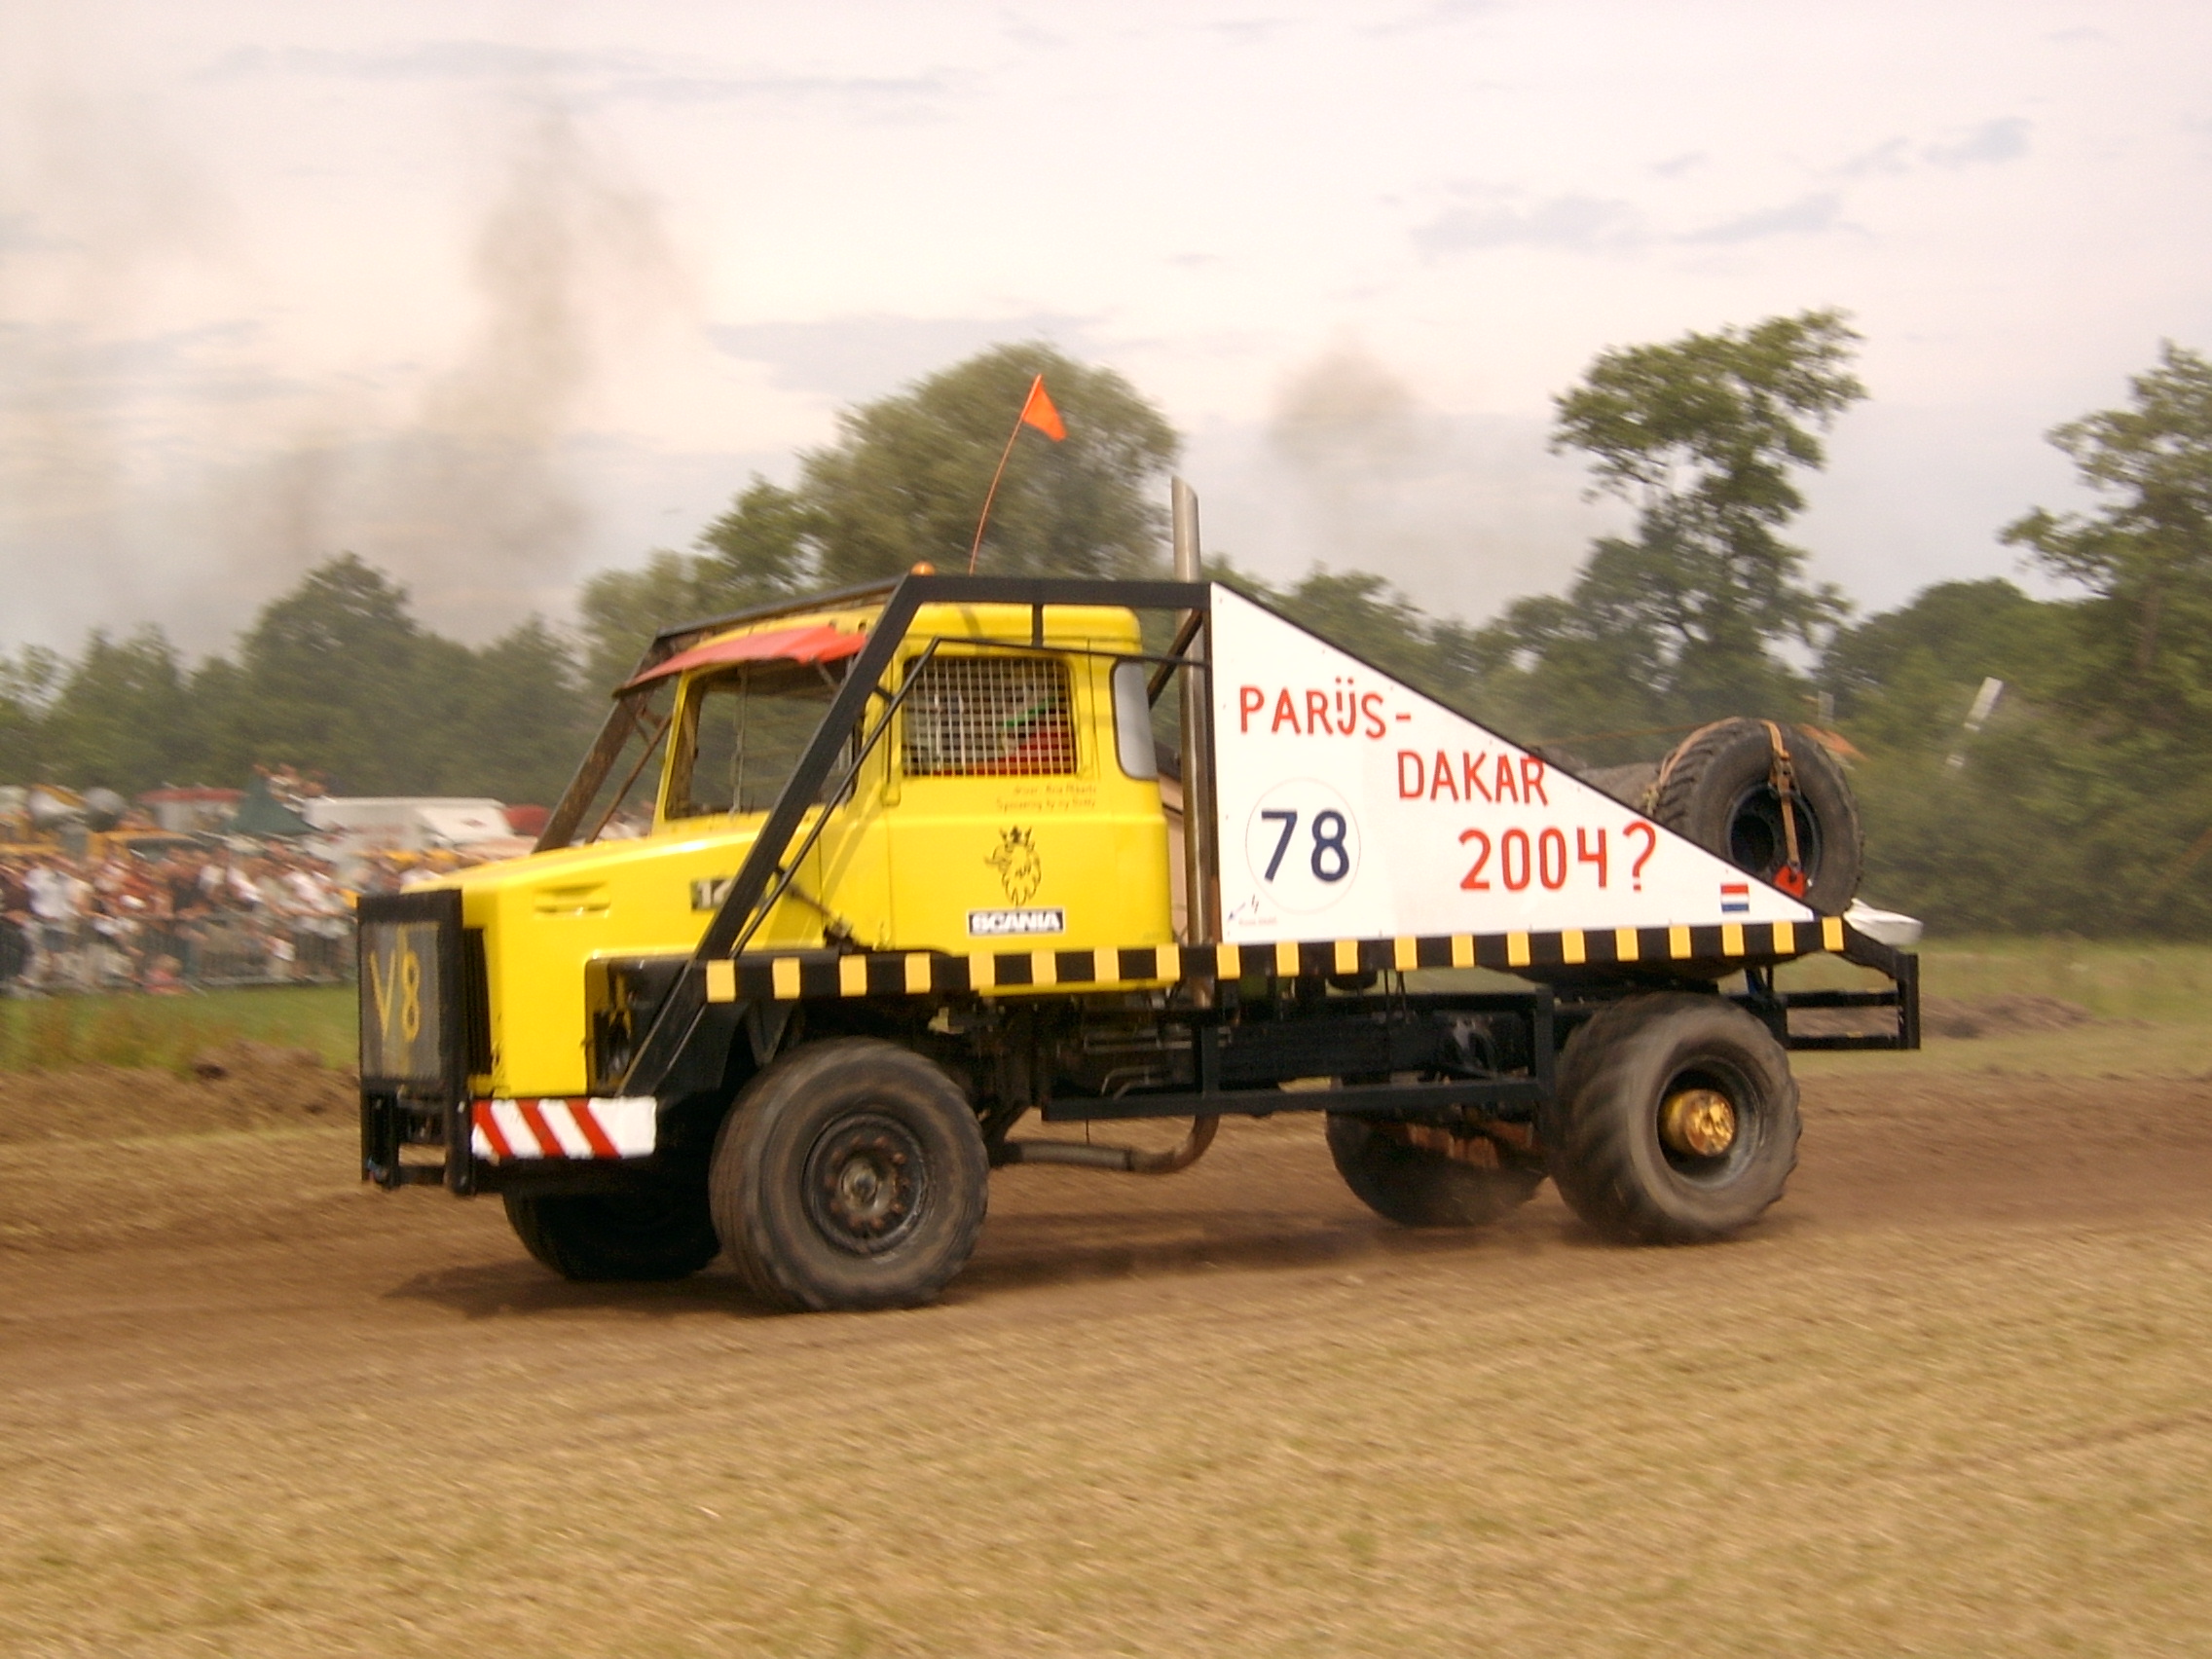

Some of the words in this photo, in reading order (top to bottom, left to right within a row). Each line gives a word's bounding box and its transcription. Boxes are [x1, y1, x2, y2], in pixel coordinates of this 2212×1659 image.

[1397, 750, 1548, 807] DAKAR
[1261, 810, 1349, 883] 78
[972, 912, 1060, 933] SCANIA
[369, 950, 421, 1044] V8
